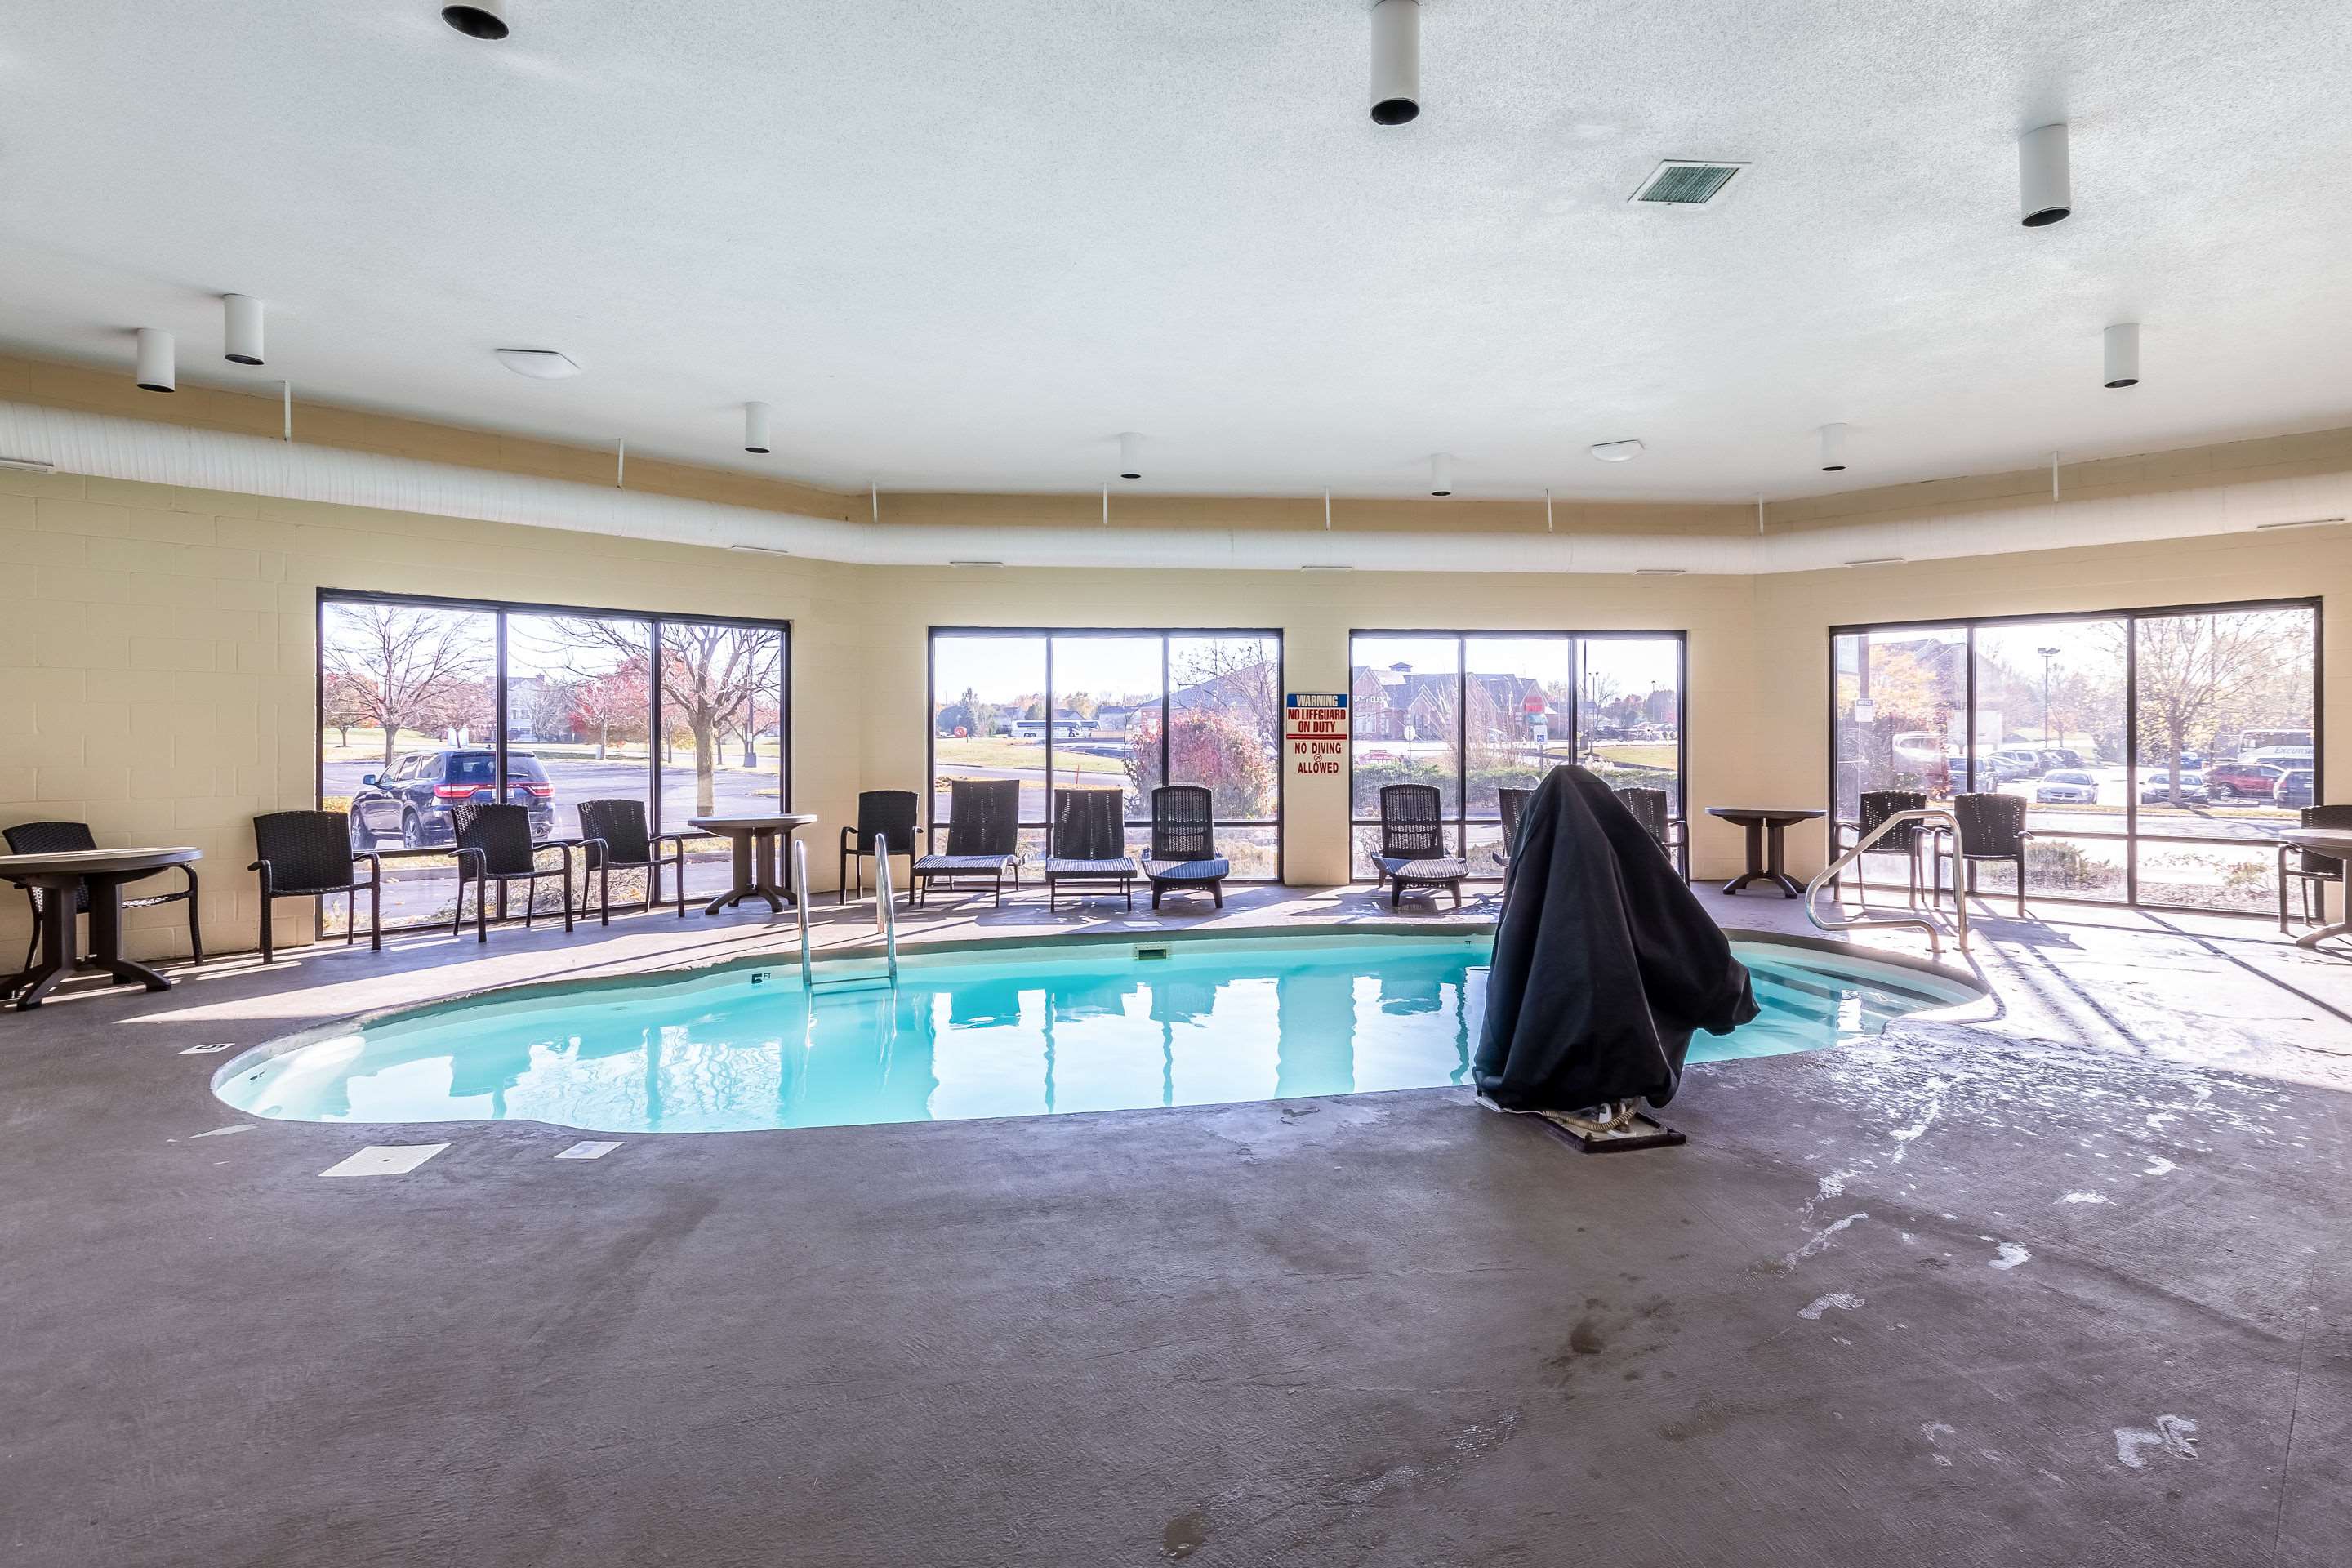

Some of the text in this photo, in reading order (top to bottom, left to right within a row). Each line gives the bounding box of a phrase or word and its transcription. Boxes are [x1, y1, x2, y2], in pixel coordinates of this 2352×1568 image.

[1297, 695, 1338, 706] WARNING
[1288, 709, 1346, 720] NO LIFEGUARD
[1298, 721, 1336, 733] ON DUTY
[1294, 742, 1342, 755] NO DIVING
[1298, 762, 1339, 773] ALLOWED
[751, 973, 763, 984] 5
